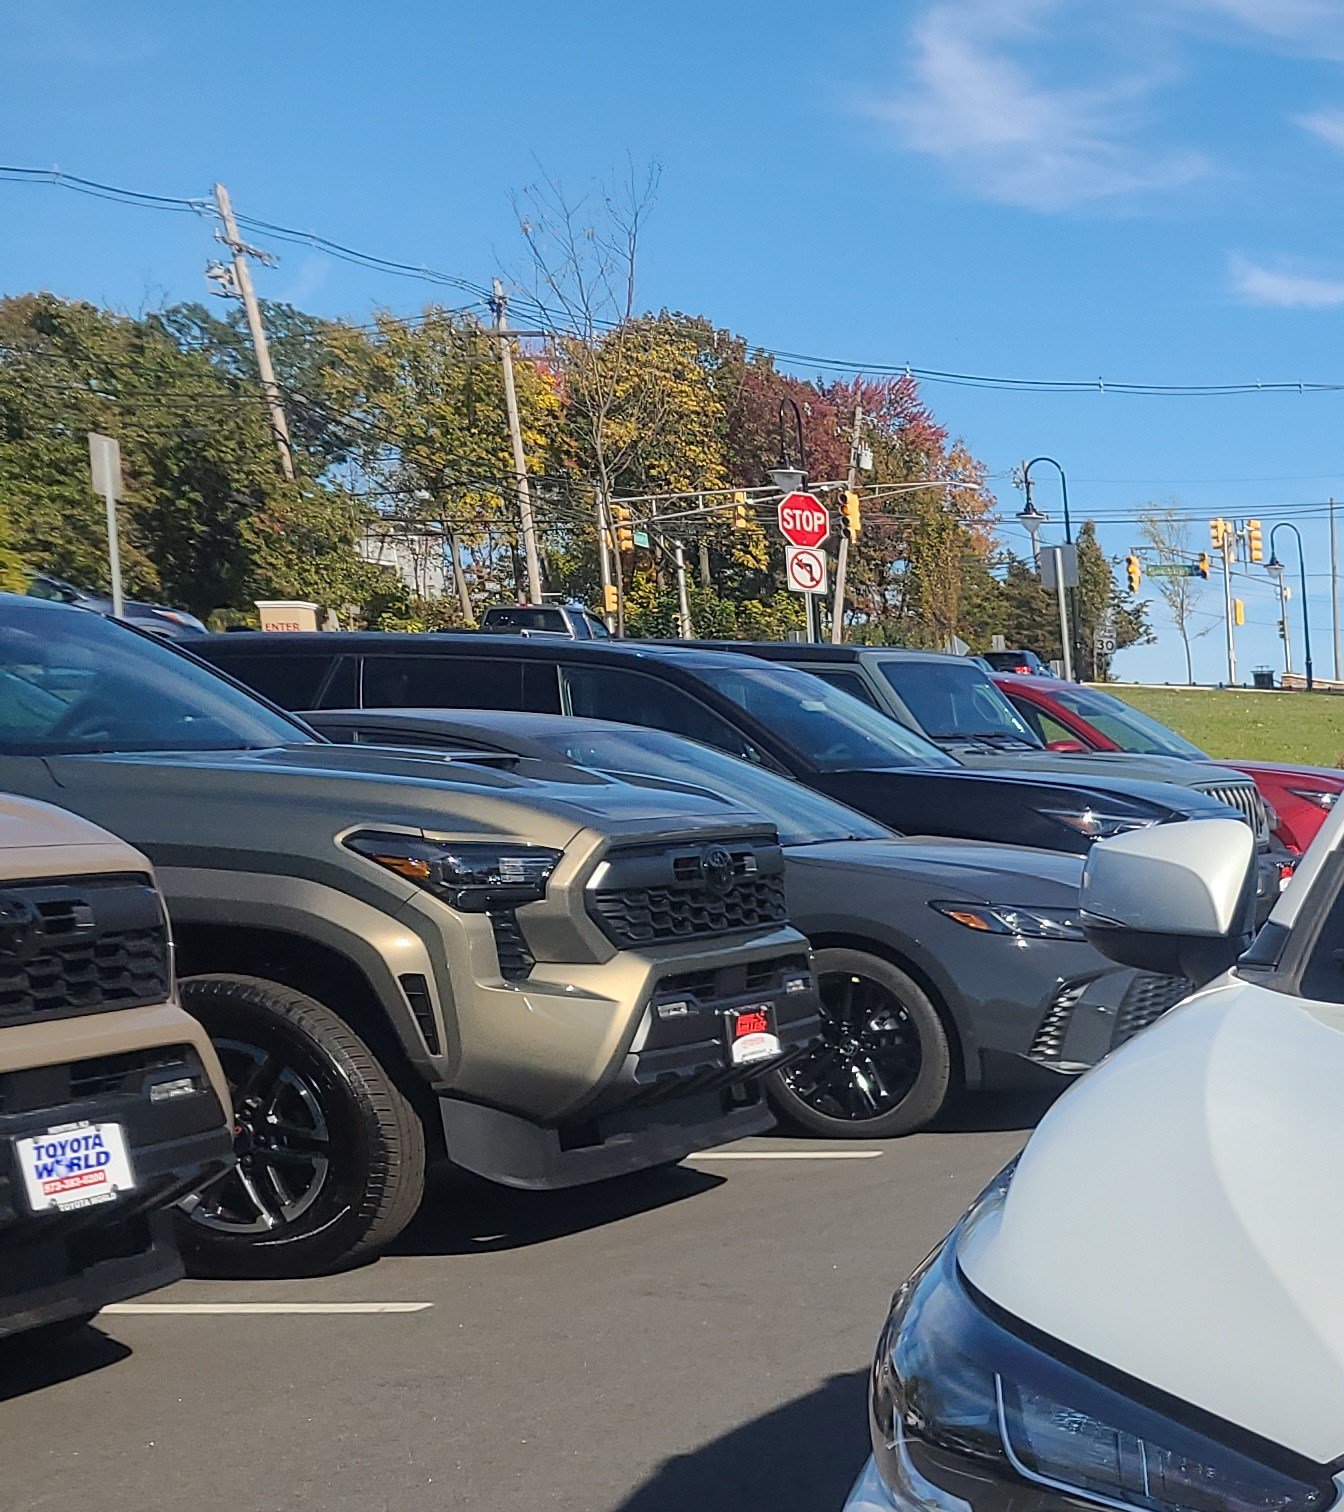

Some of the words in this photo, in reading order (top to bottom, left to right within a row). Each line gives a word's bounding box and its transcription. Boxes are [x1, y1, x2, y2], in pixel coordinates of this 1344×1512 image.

[782, 508, 825, 533] STOP
[265, 622, 300, 631] ENTER
[1096, 640, 1114, 650] 30
[33, 1133, 104, 1162] TOYOTA
